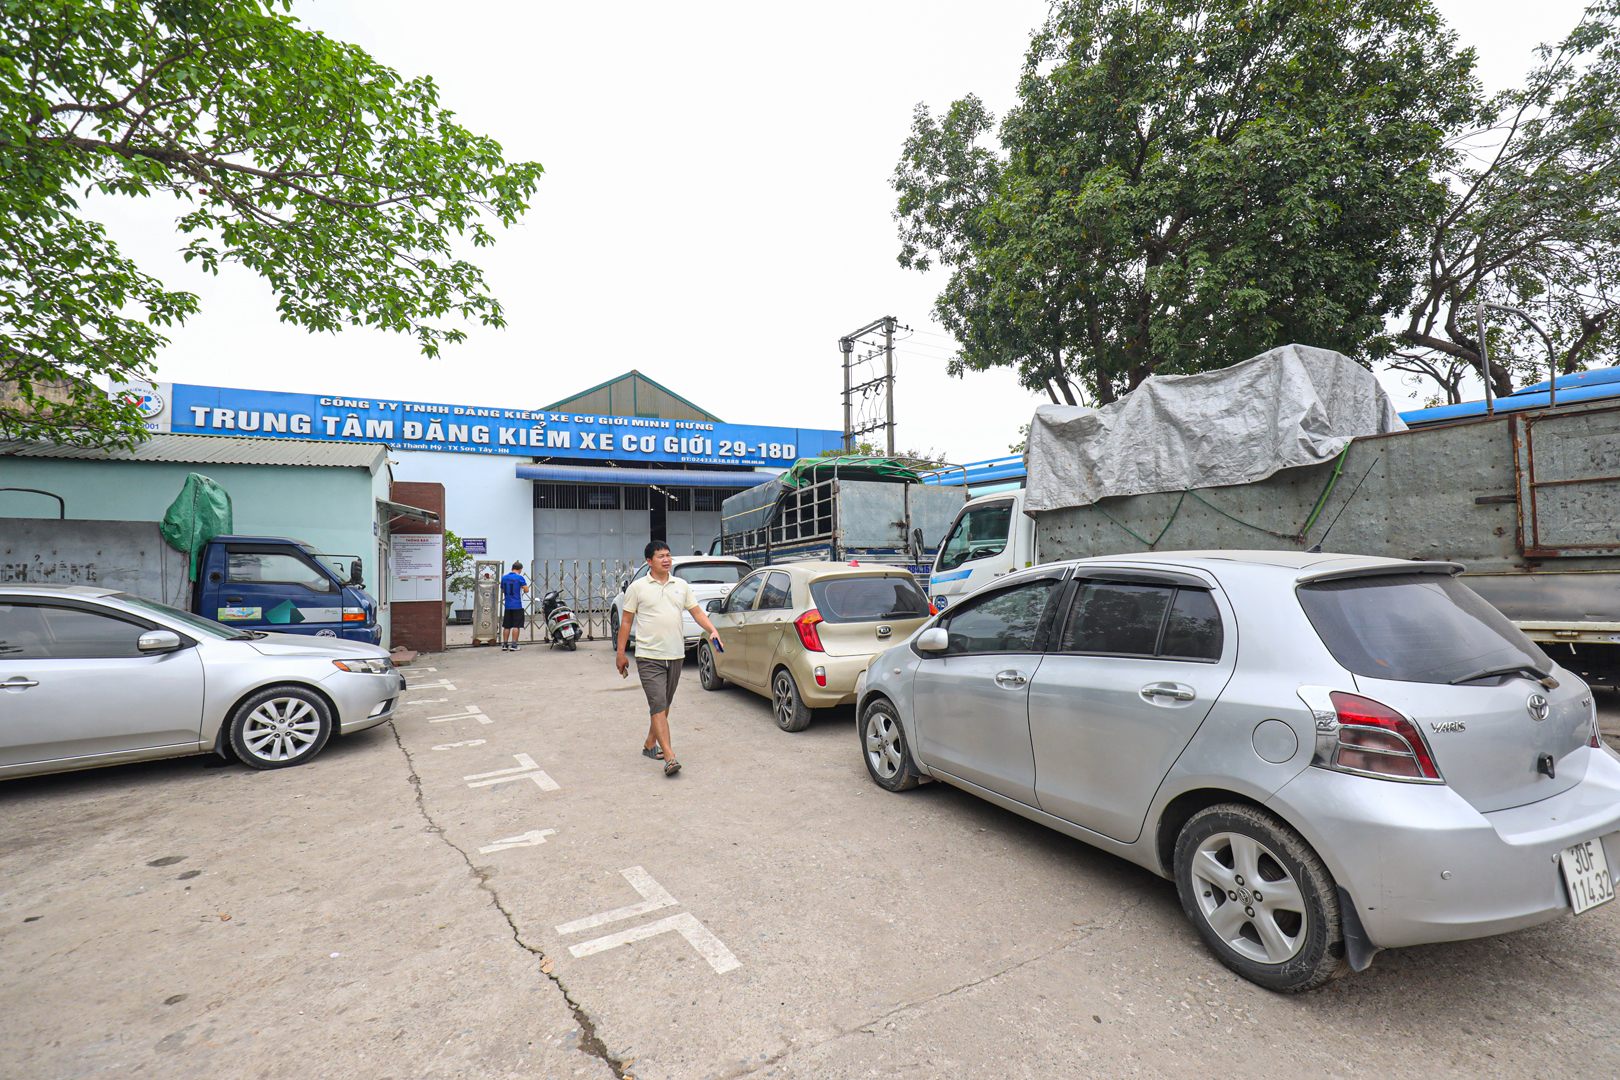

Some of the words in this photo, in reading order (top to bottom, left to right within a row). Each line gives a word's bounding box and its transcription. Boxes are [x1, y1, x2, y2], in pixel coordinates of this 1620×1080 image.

[320, 396, 370, 409] CÔNG
[377, 402, 399, 411] TY
[403, 403, 450, 414] TNHH
[453, 406, 500, 418] ĐĂNG
[504, 409, 545, 421] KIỂM
[549, 414, 570, 423] XE
[574, 415, 594, 424] CƠ
[598, 416, 628, 426] GIỚI
[631, 419, 670, 429] MINH
[675, 421, 714, 431] HƯNG
[190, 405, 311, 434] TRUNG
[322, 412, 394, 439] TÂM
[402, 417, 490, 444] ĐĂNG
[499, 421, 571, 449] KIỂM
[579, 431, 614, 451] XE
[622, 434, 657, 453] CƠ
[664, 434, 712, 455] GIỚI
[718, 440, 796, 460] 29-18D
[430, 444, 442, 452] Mỹ
[478, 446, 493, 454] Tây
[503, 582, 515, 596] 11
[1571, 841, 1594, 875] 30F
[1572, 869, 1613, 910] 114.32
